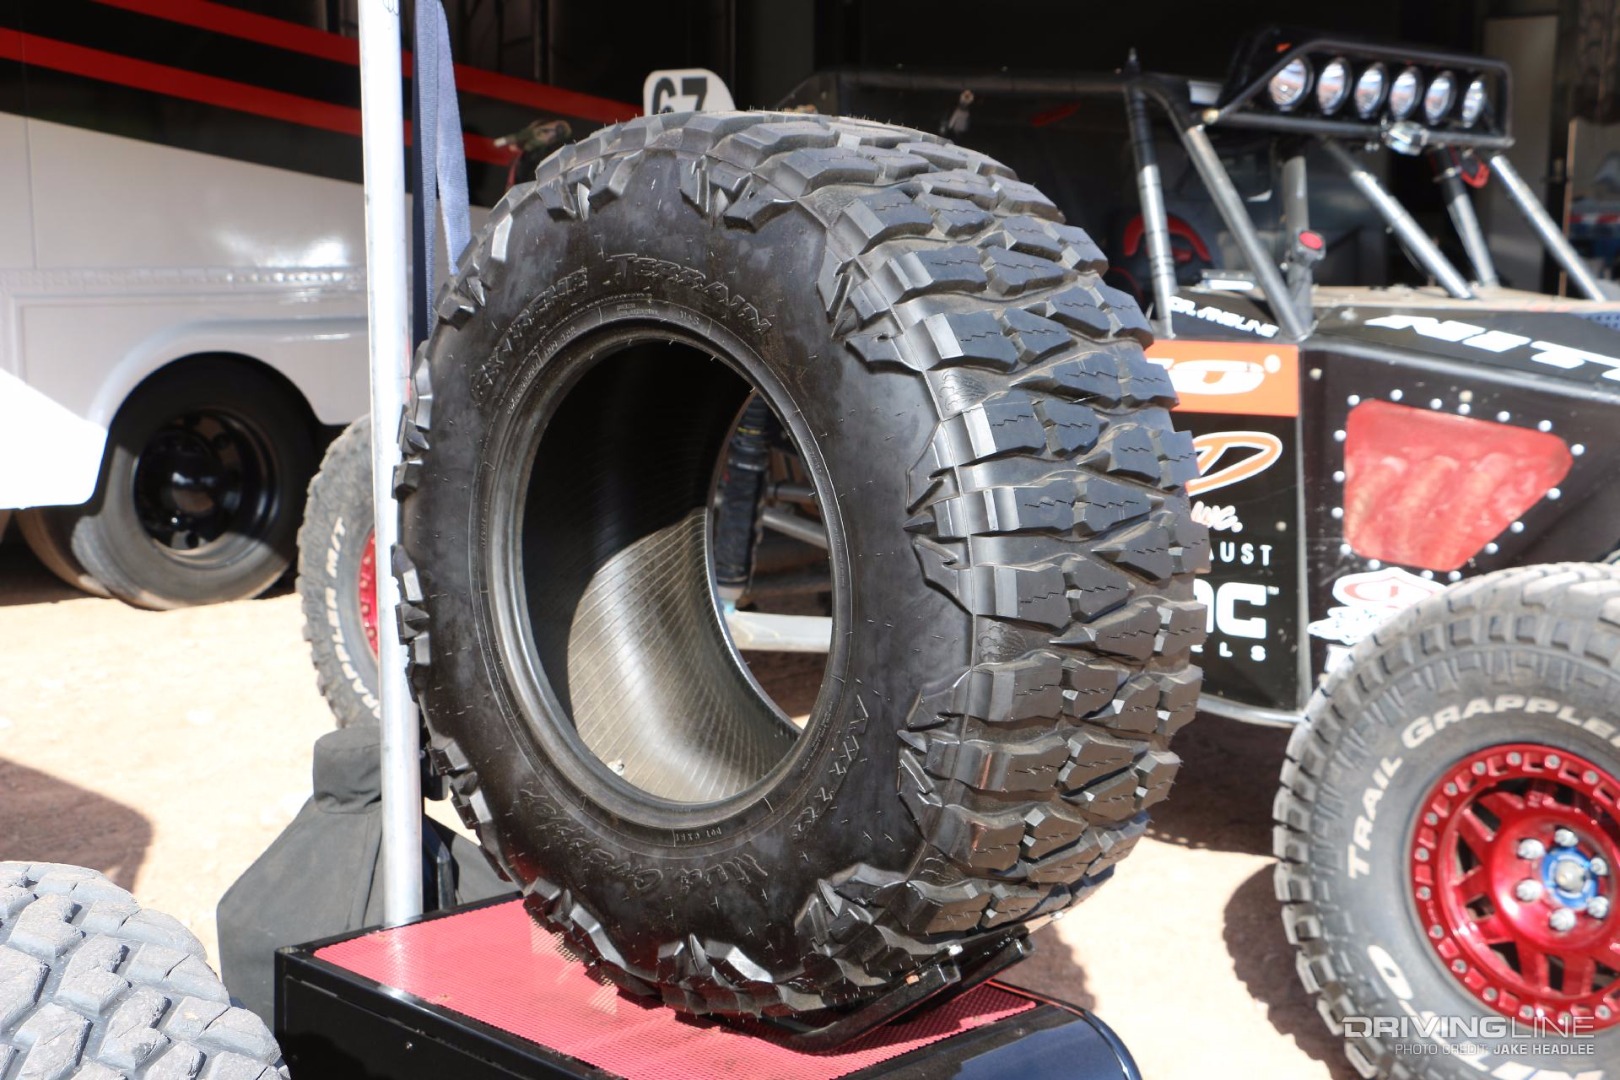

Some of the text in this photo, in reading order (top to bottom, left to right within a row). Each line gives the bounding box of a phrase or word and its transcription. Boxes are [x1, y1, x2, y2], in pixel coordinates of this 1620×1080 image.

[651, 77, 708, 114] 67
[1347, 694, 1620, 880] TRAIL GRAPPLE
